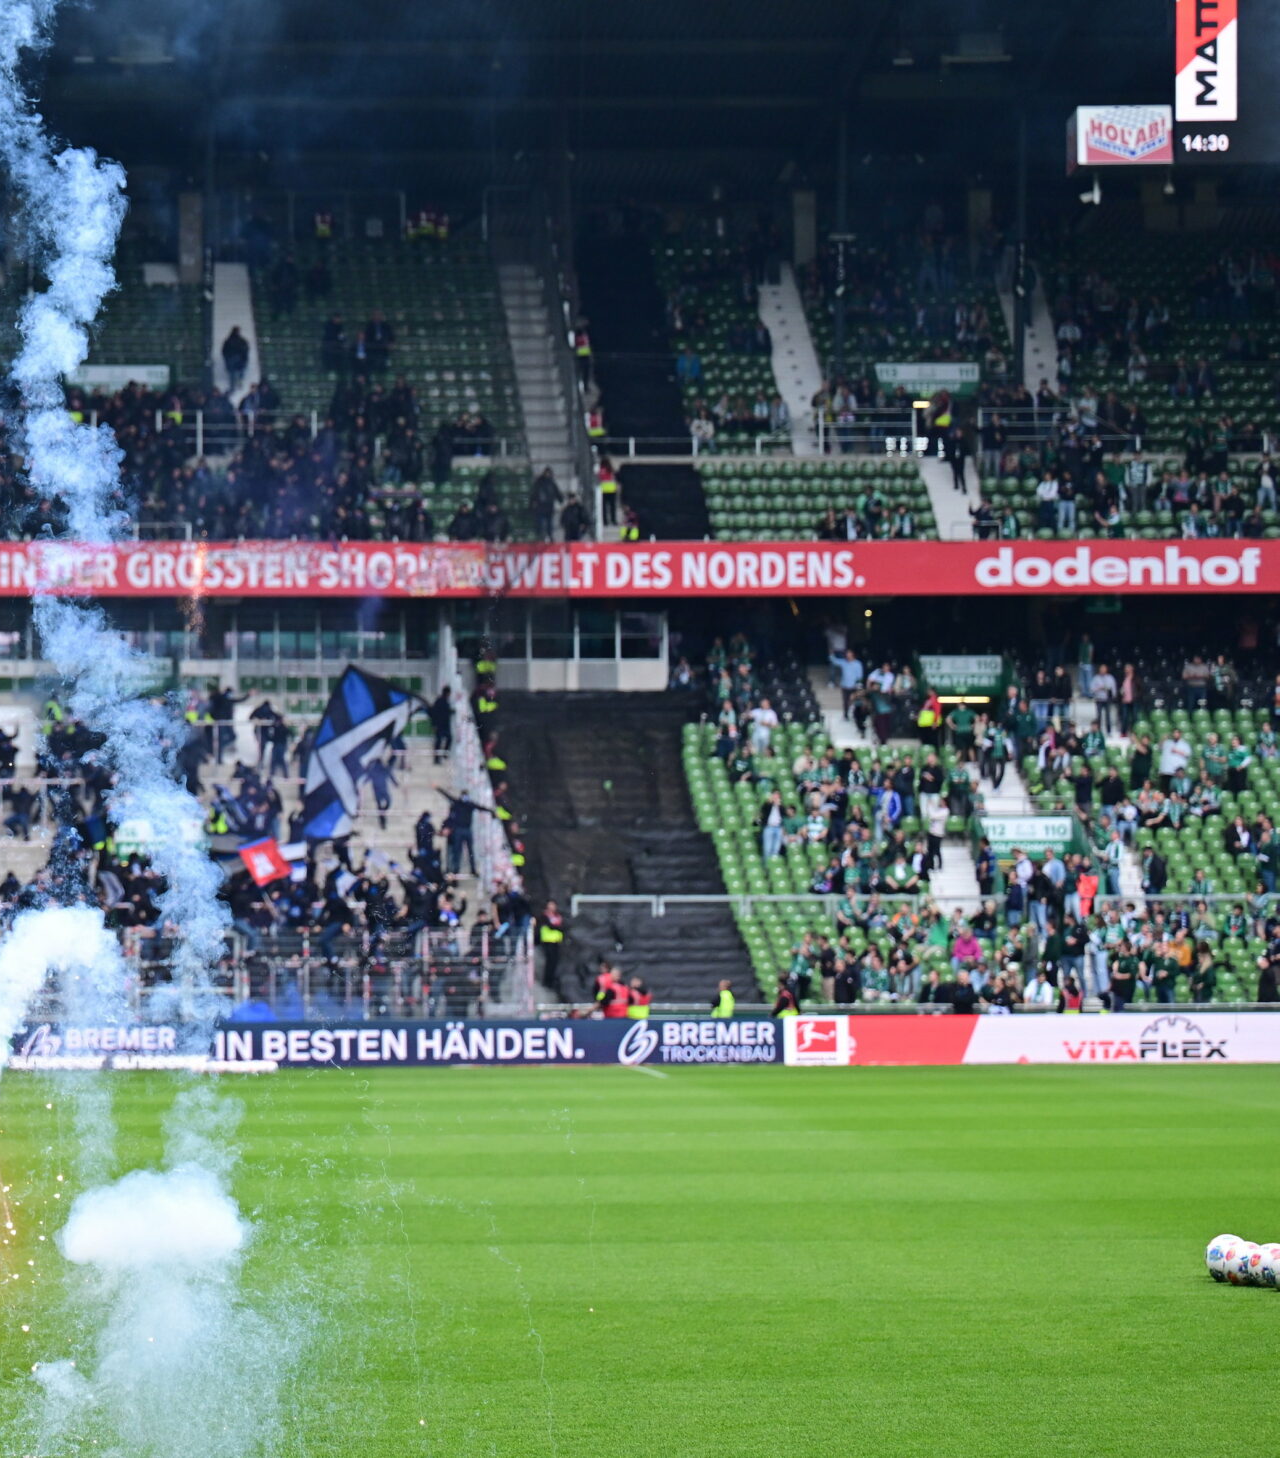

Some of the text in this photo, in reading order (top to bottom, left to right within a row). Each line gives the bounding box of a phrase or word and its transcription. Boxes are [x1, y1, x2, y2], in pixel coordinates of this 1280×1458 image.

[1182, 133, 1230, 152] 14:30
[0, 552, 39, 588] IN
[606, 552, 672, 589] DES
[682, 551, 866, 589] NORDENS.
[975, 546, 1261, 587] dodenhof
[1044, 824, 1068, 836] 110
[65, 1022, 585, 1061] BREMER IN BESTEN HÄNDEN.
[662, 1021, 776, 1045] BREMER
[660, 1045, 776, 1062] TROCKENBAU
